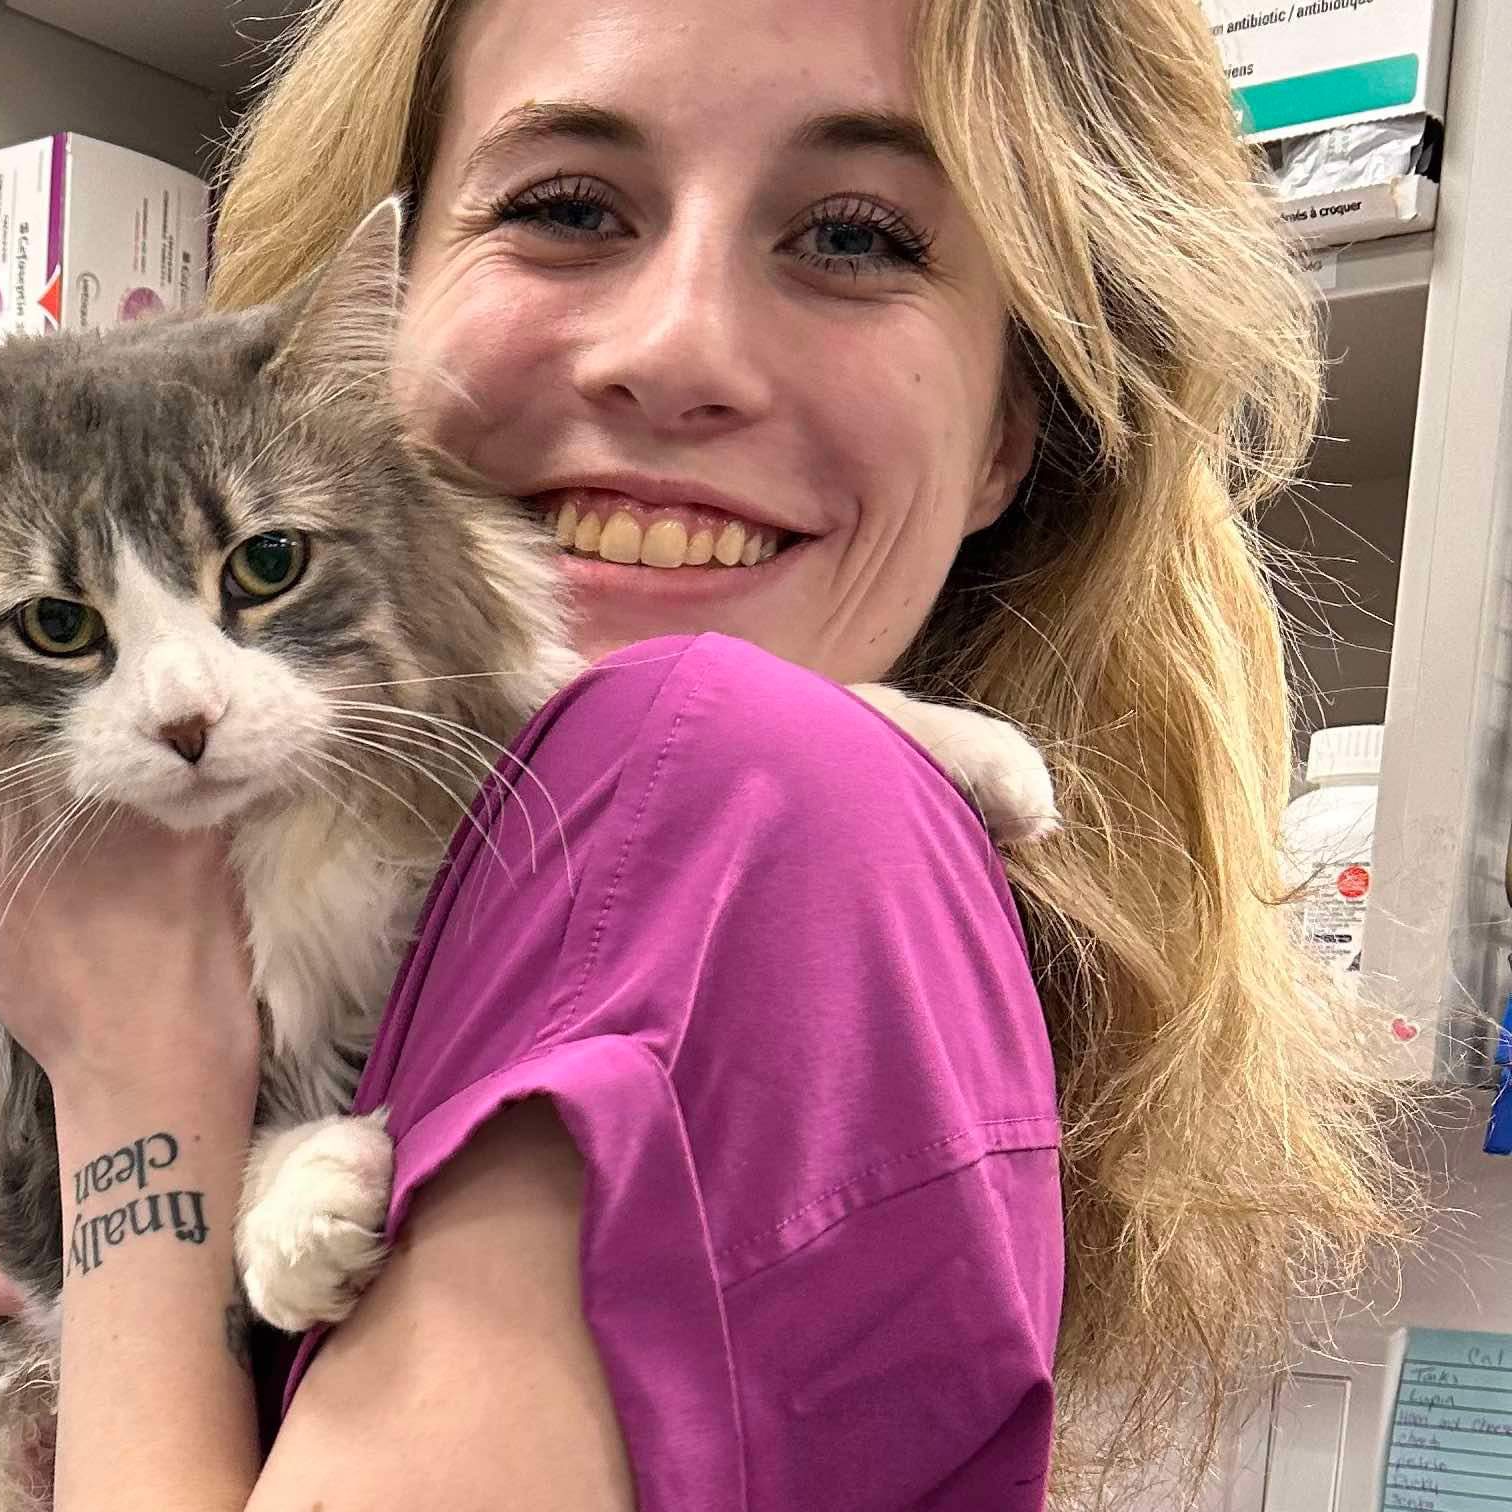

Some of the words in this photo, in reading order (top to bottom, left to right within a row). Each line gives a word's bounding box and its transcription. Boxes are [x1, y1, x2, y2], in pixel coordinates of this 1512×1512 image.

[1227, 9, 1286, 33] antibiotic
[1319, 201, 1363, 218] croquer
[66, 1190, 211, 1278] finally
